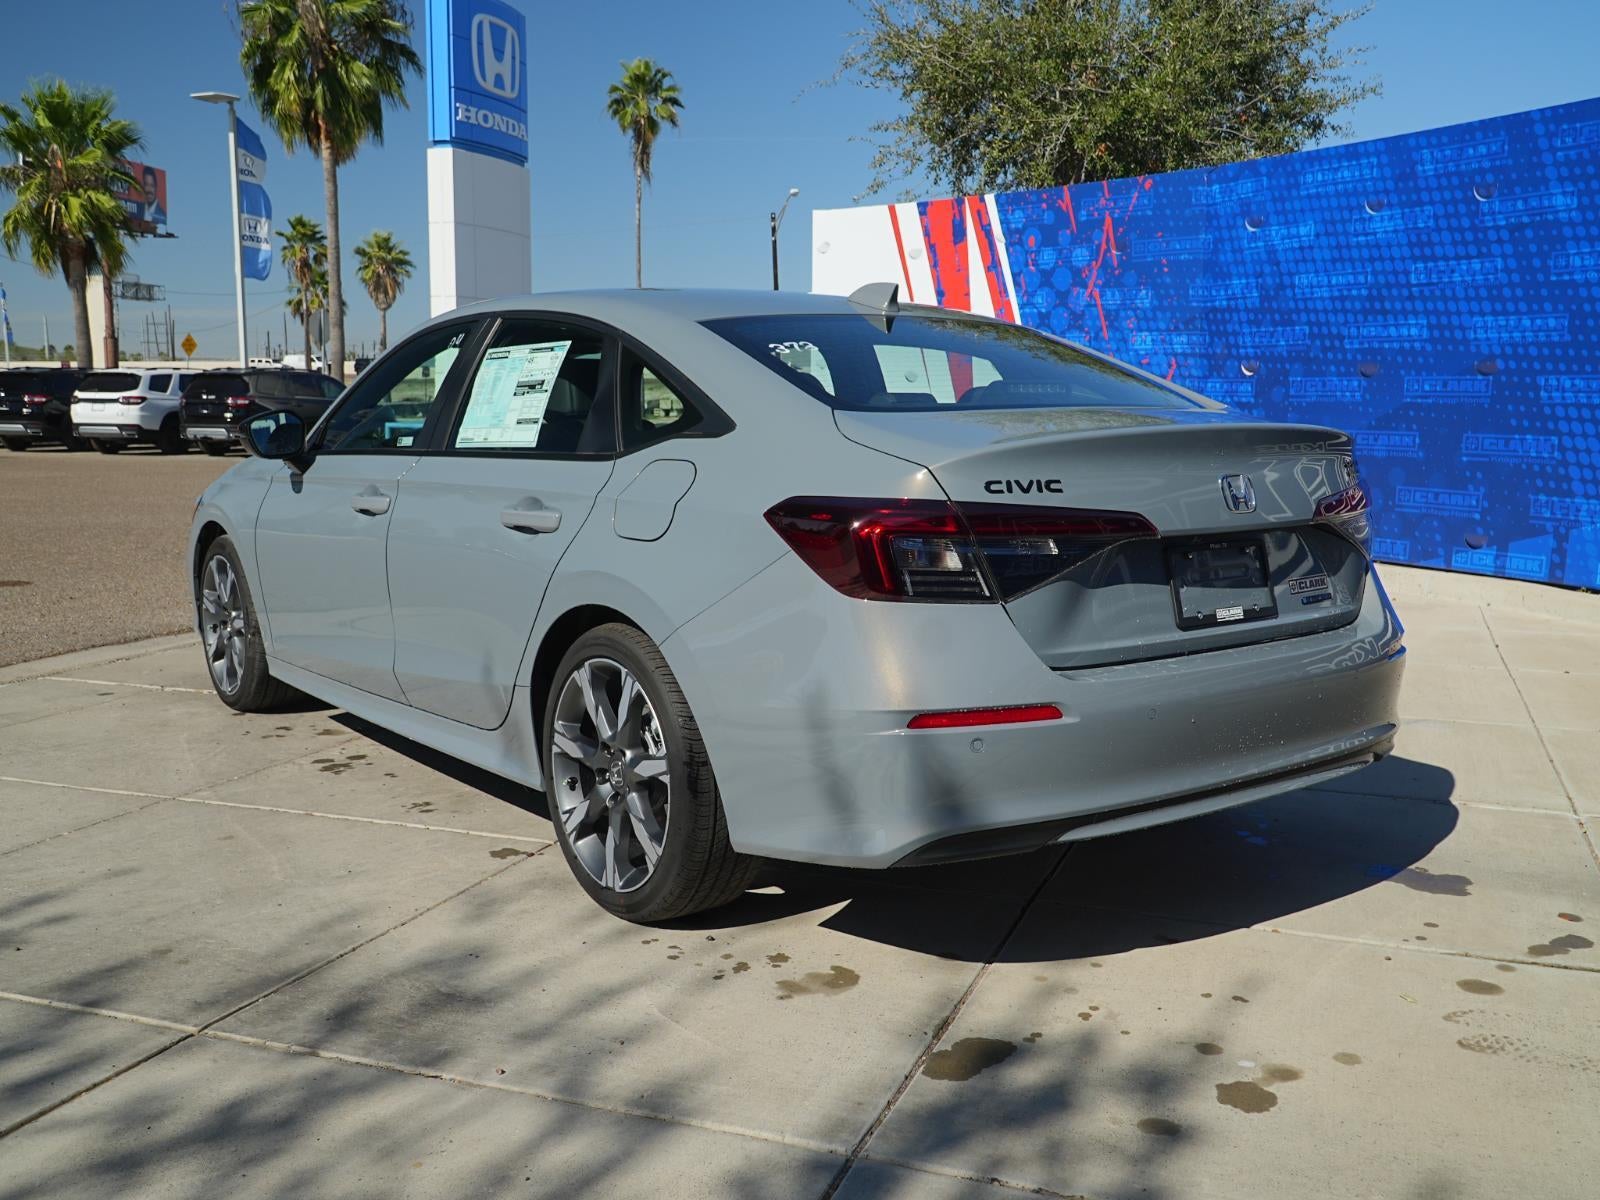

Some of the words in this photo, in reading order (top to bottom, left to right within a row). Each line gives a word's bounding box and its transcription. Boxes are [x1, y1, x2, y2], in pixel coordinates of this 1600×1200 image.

[456, 102, 529, 141] HONDA
[1483, 438, 1553, 454] CLARK
[983, 479, 1064, 494] CIVIC
[1414, 490, 1479, 506] CLARK
[1298, 577, 1327, 590] CLARK
